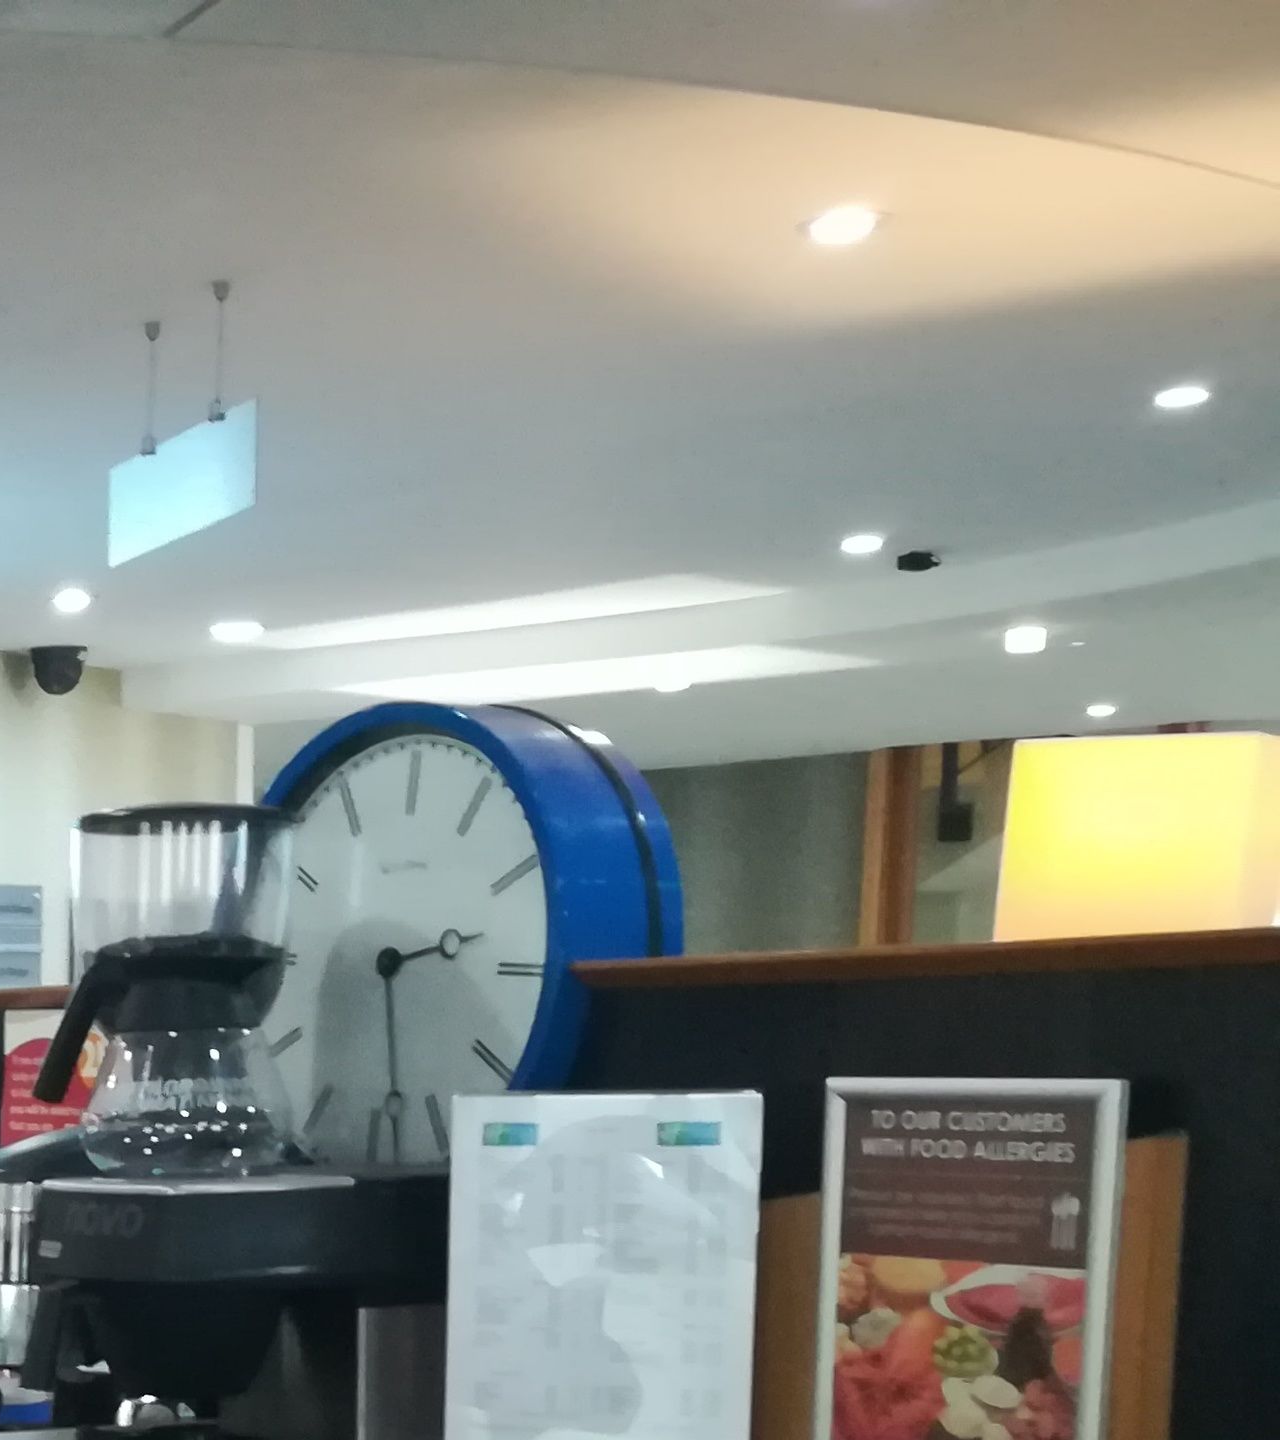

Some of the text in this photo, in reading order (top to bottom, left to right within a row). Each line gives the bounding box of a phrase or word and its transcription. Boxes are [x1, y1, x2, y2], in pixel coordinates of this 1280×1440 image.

[871, 1109, 1067, 1133] TO OUR CUSTOMERS
[910, 1138, 968, 1160] FOOD
[973, 1140, 1077, 1164] ALLERGIES
